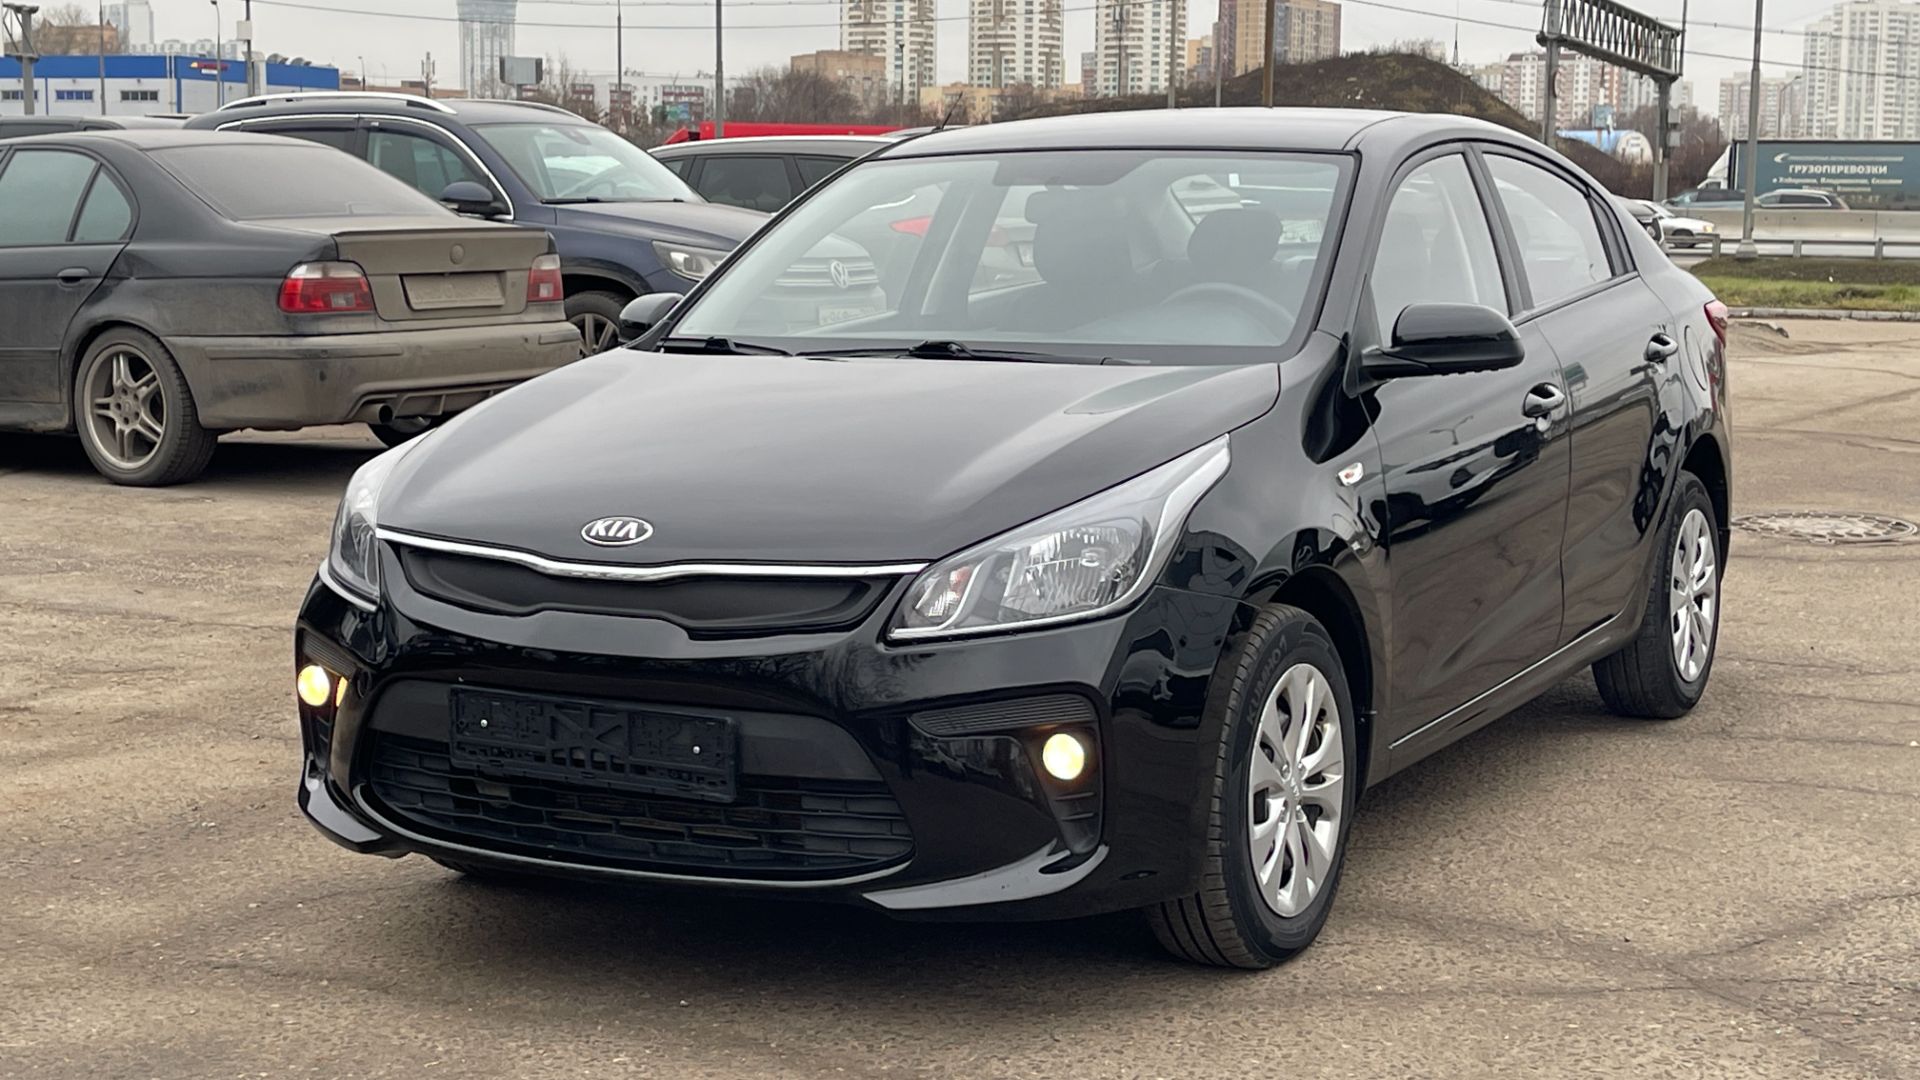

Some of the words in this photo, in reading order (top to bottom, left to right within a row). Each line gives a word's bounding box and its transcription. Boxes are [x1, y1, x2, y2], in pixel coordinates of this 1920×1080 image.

[1788, 164, 1888, 174] ГРУЗОПЕРЕВОЗКИ
[589, 520, 639, 539] KIA
[1247, 647, 1282, 725] KUMHO
